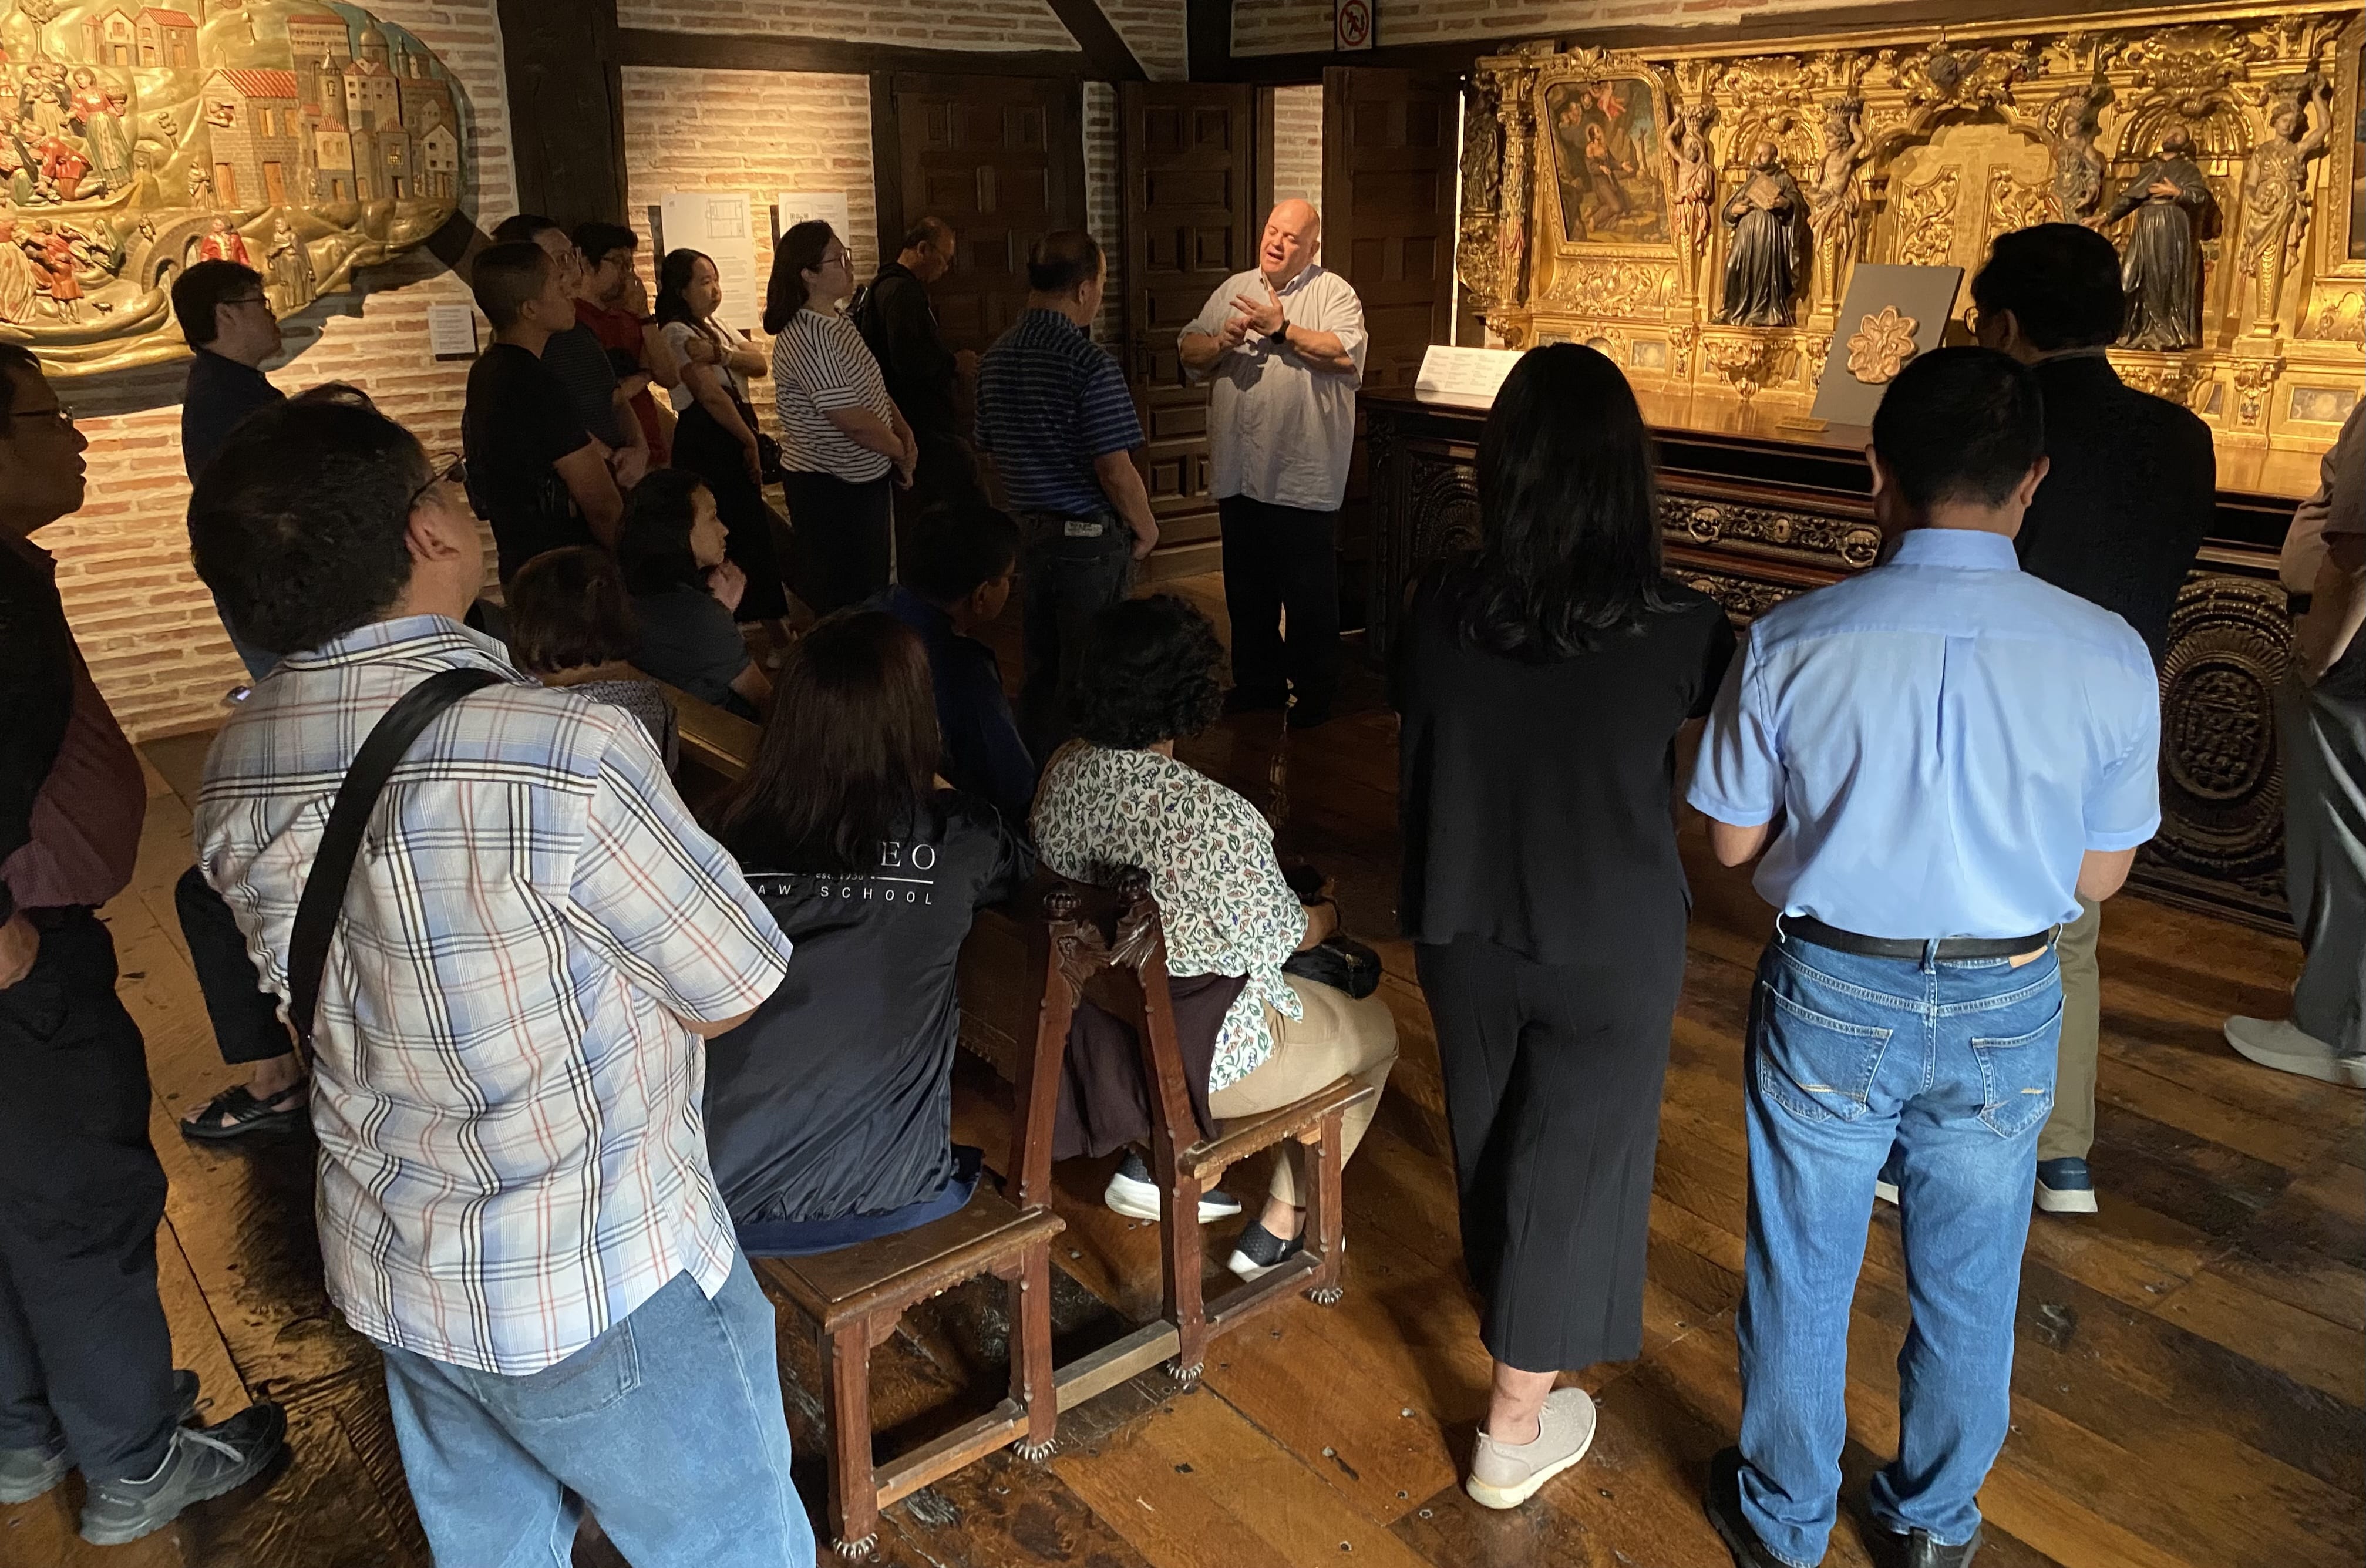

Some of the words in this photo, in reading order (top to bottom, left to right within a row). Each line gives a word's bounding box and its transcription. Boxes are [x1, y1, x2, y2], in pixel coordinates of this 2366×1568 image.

[880, 841, 935, 870] EO
[758, 884, 791, 895] AW
[820, 886, 932, 905] SCHOOL
